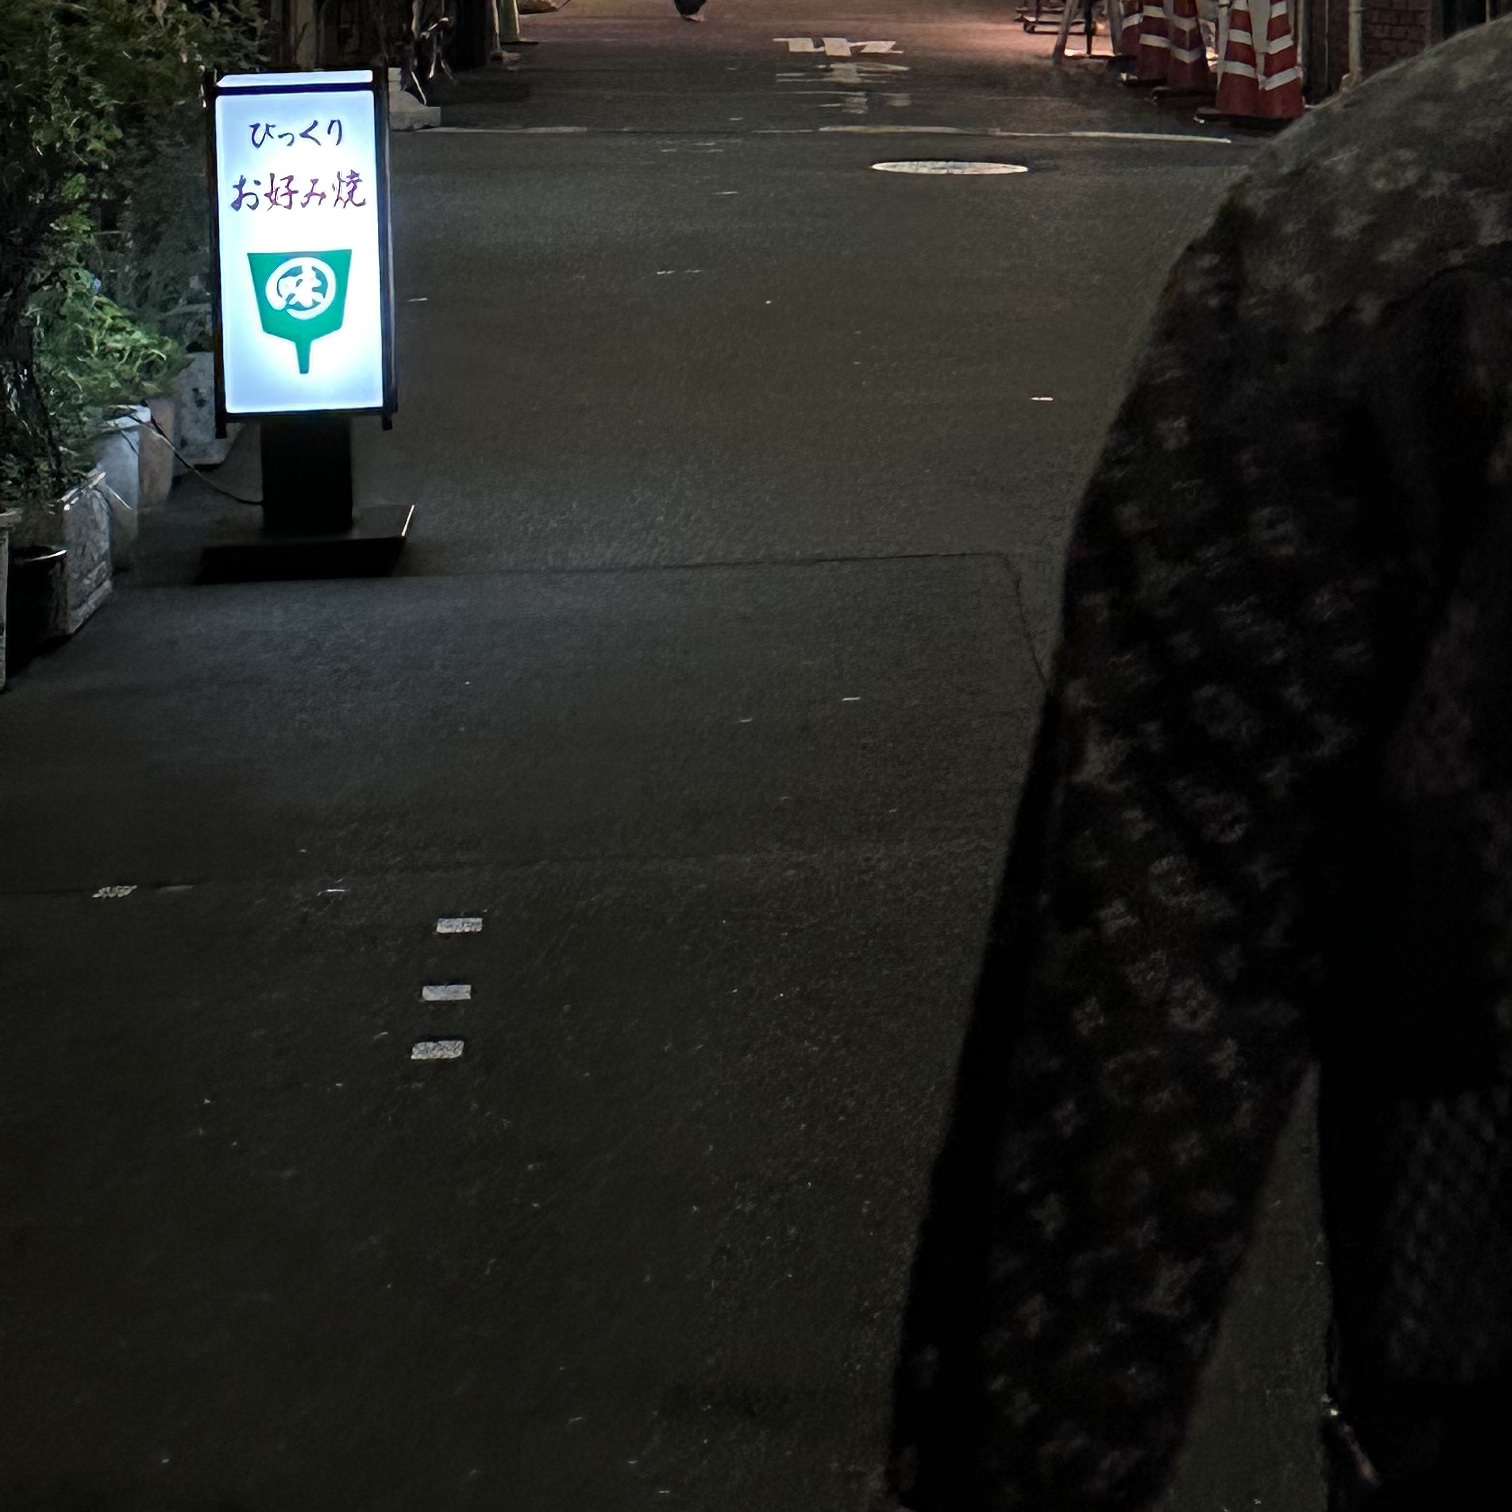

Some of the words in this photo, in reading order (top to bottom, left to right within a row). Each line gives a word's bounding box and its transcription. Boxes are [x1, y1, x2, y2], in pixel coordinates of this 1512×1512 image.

[249, 119, 343, 149] びっくり
[231, 170, 367, 212] お好み焼
